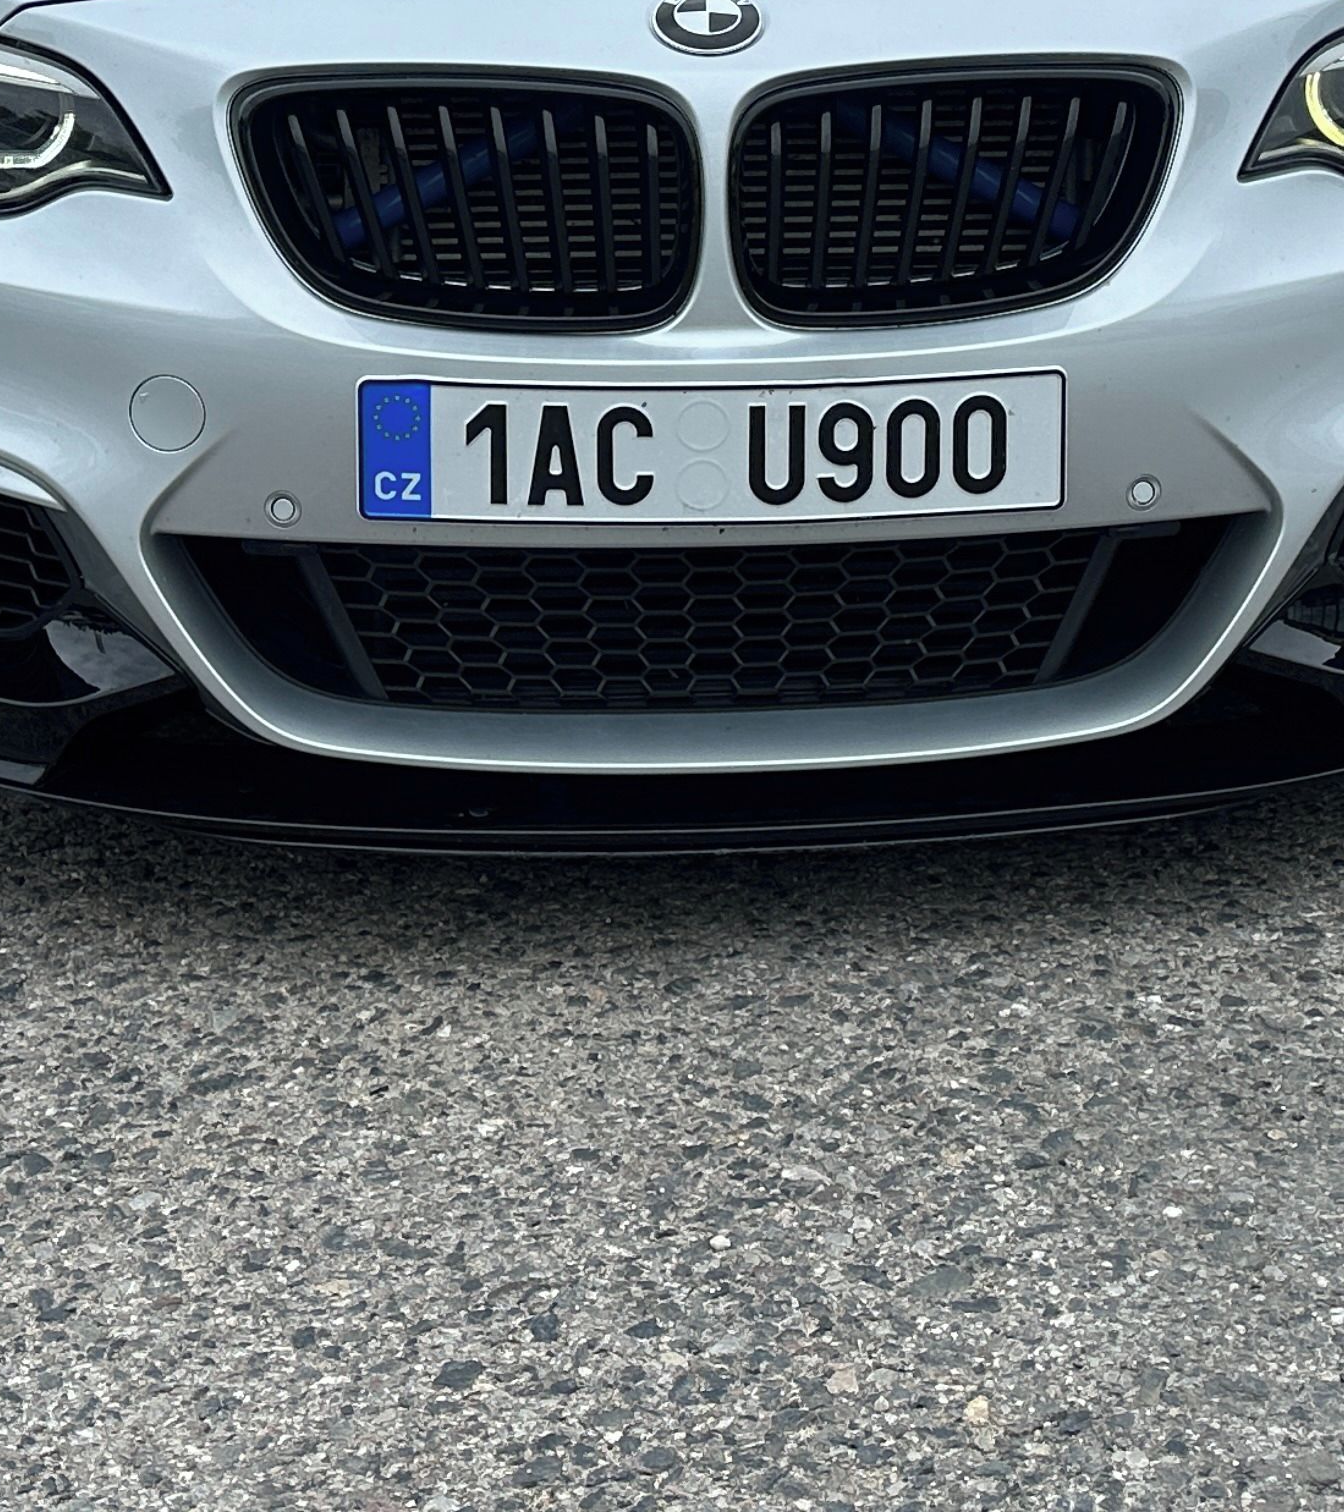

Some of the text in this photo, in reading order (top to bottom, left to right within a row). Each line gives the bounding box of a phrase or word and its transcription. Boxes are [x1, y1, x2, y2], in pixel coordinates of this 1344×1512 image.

[374, 471, 422, 501] CZ
[465, 395, 1007, 507] 1AC U900
